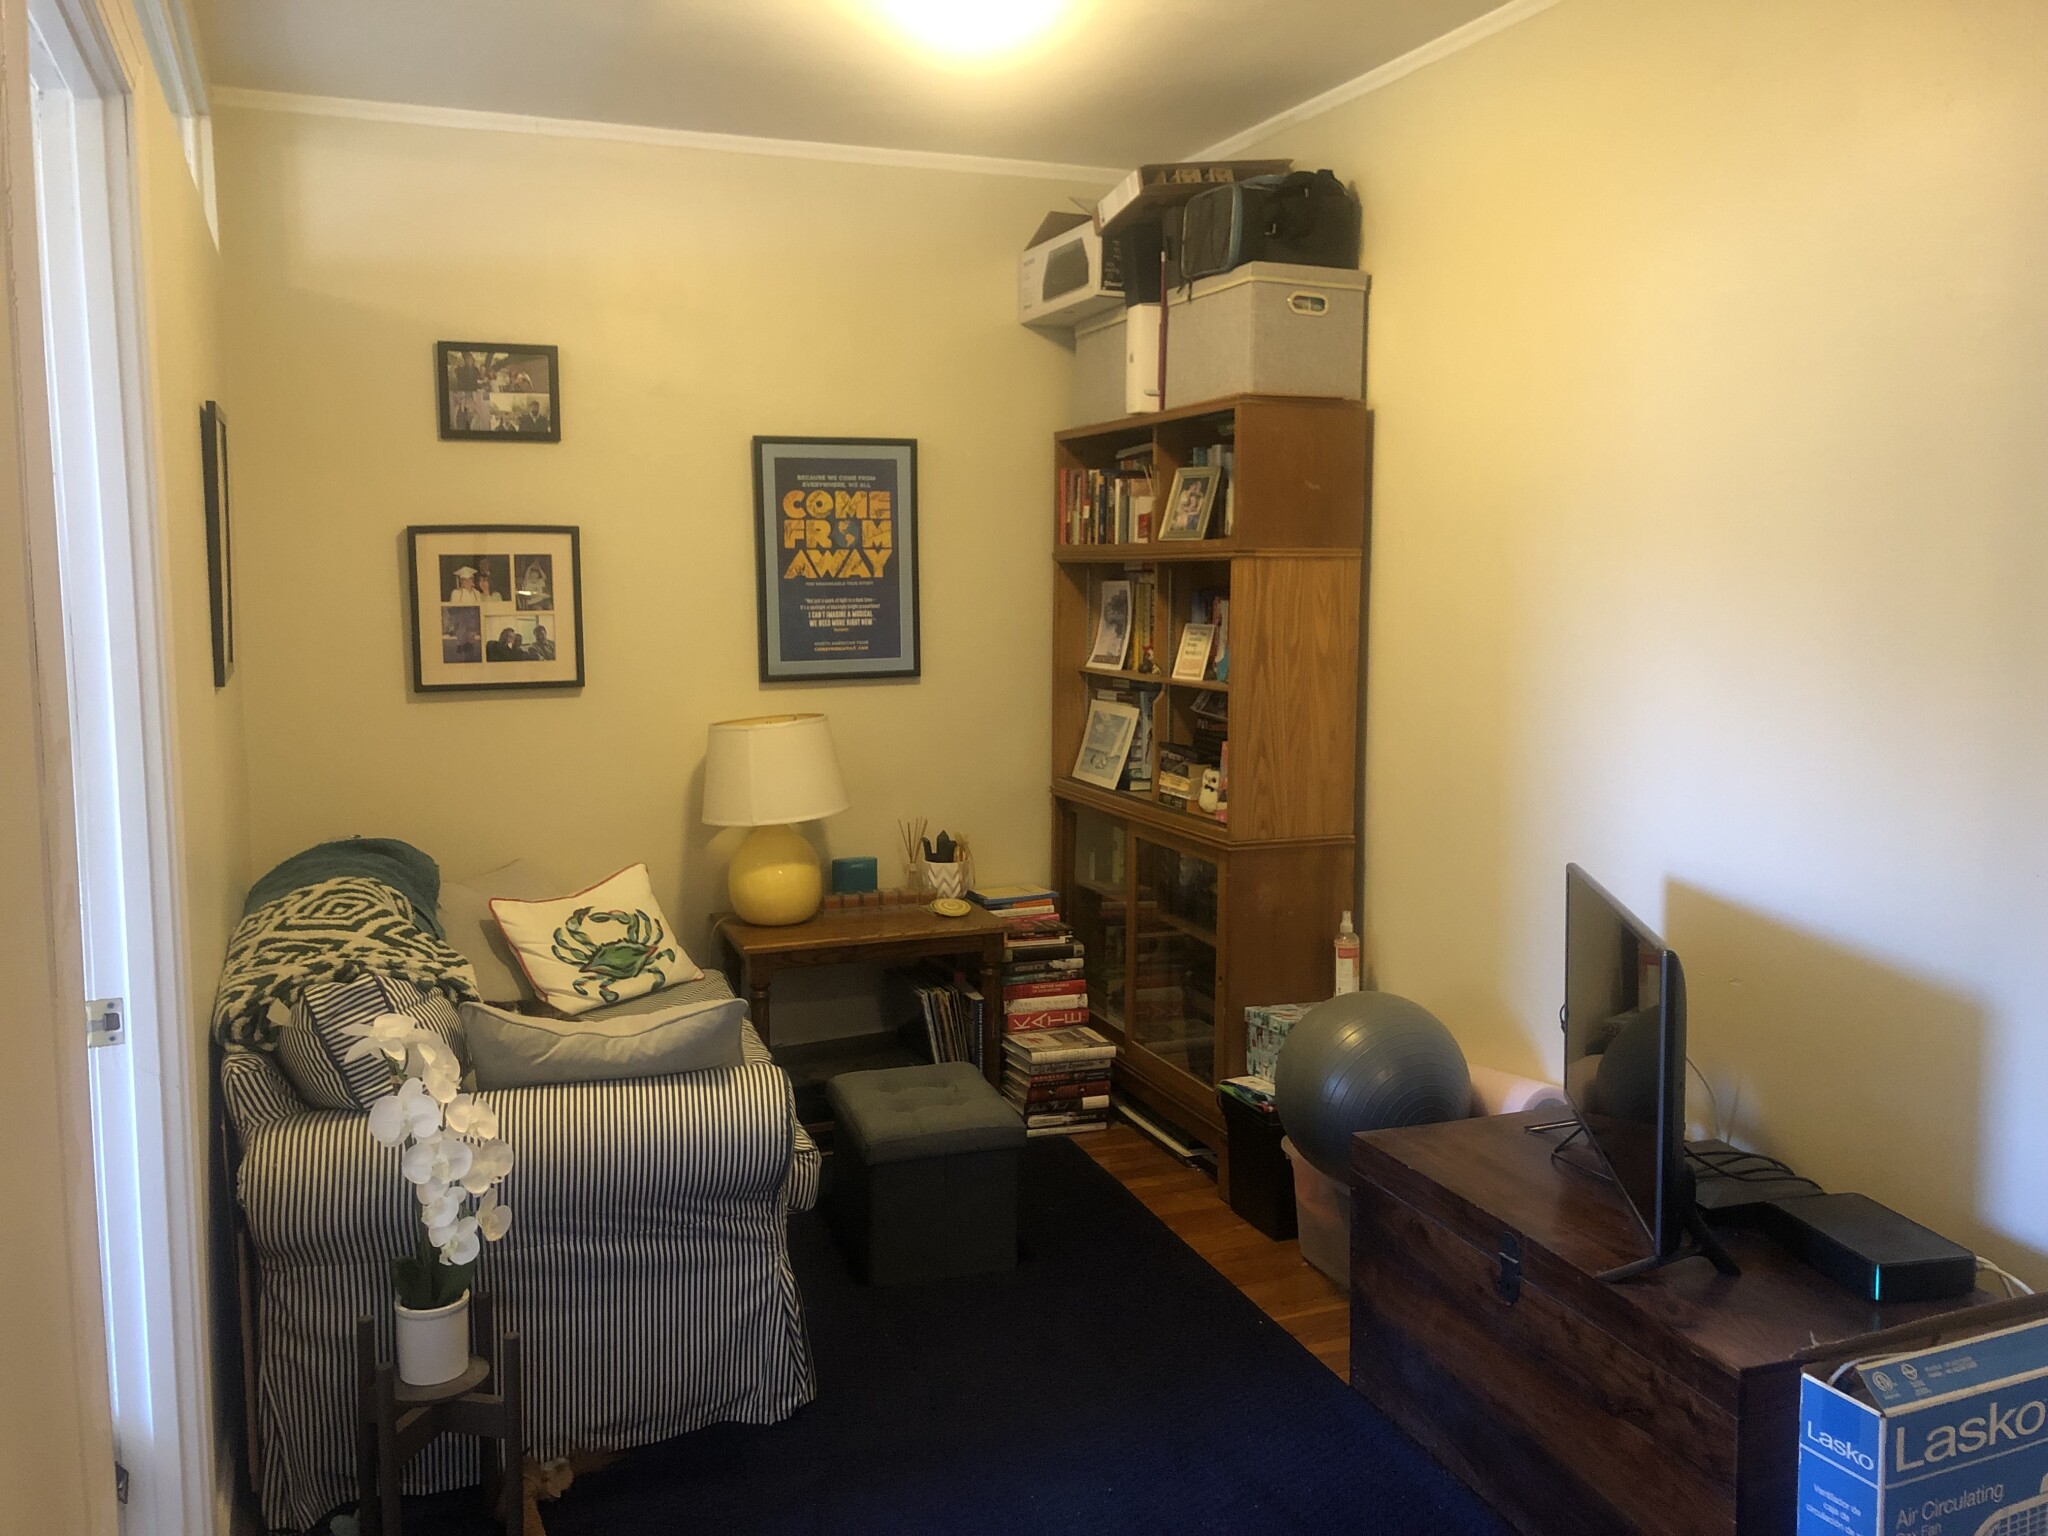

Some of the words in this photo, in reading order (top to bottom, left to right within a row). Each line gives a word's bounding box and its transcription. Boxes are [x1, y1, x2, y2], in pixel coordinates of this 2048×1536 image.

[783, 490, 891, 519] COME
[784, 549, 893, 579] AWAY
[1013, 1012, 1082, 1030] KATE
[1807, 1420, 1875, 1471] Lasko
[1896, 1401, 2046, 1472] Lasko
[1896, 1507, 1919, 1529] Air
[1921, 1484, 2005, 1521] Circulating
